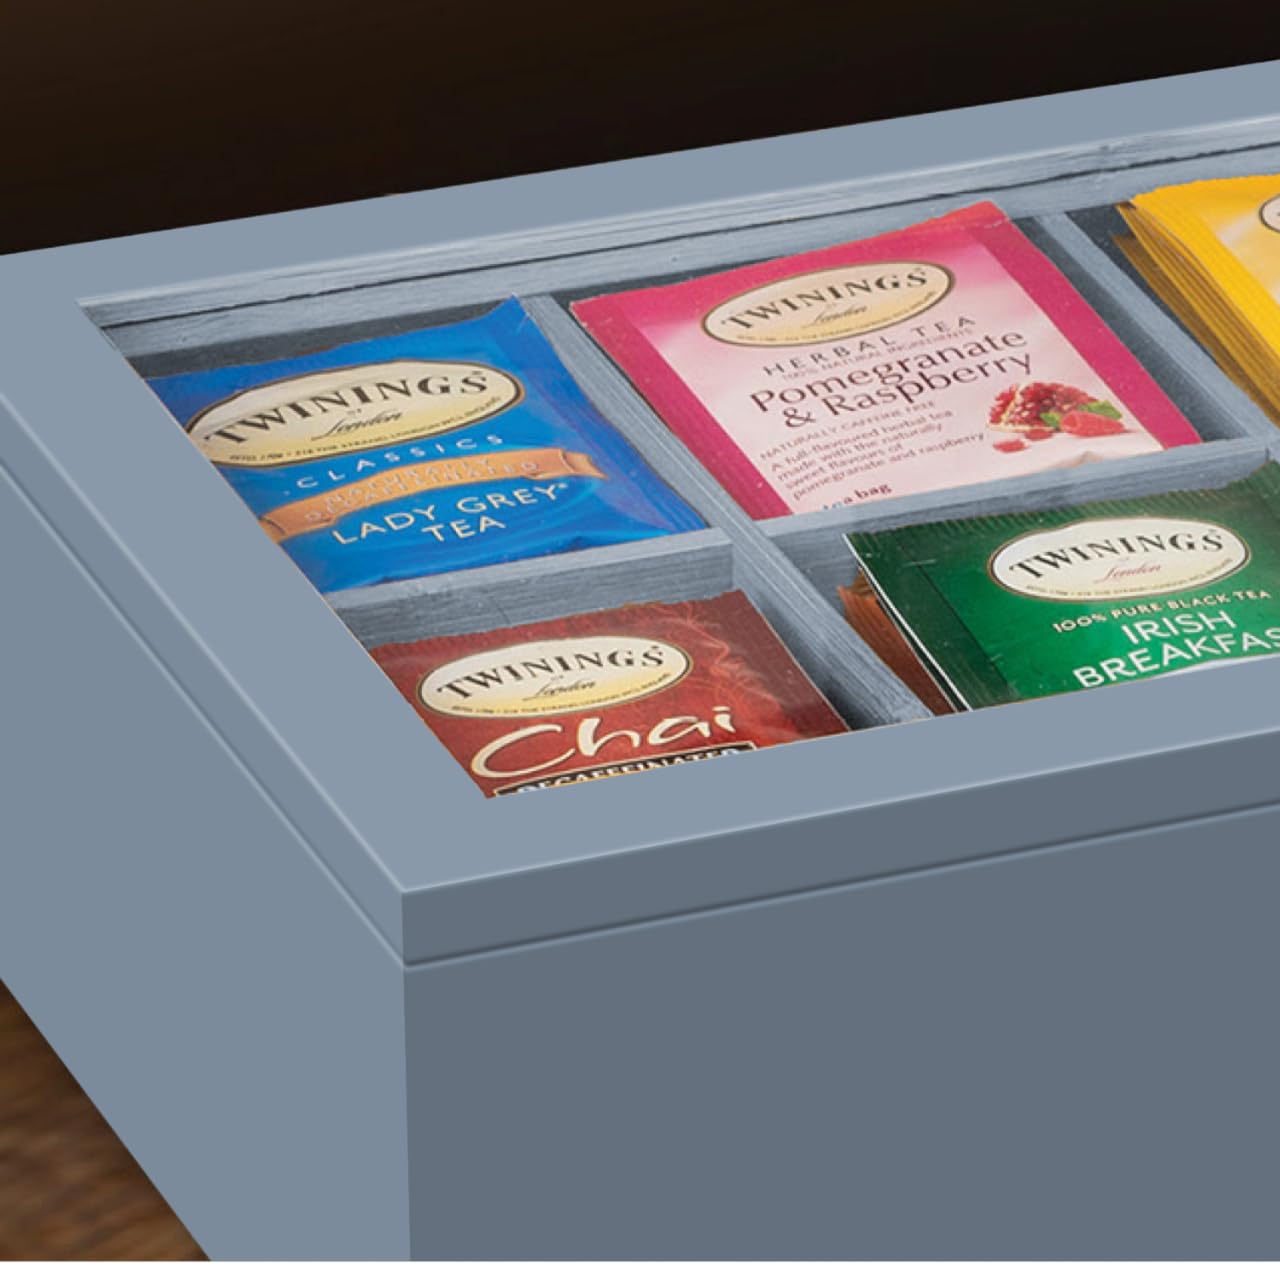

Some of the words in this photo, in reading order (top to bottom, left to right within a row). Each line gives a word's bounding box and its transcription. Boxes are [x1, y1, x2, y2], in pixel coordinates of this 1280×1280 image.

[721, 271, 928, 329] TWININGS
[749, 330, 1028, 412] Pomegranate
[762, 336, 896, 376] HERBAL
[912, 315, 976, 336] TEA
[204, 375, 488, 444] TWININGS
[783, 405, 816, 429] &
[825, 353, 1034, 418] Raspberry
[760, 425, 837, 461] NATURALLY
[881, 416, 926, 434] herbal
[929, 410, 954, 420] tea
[296, 434, 503, 489] CLASSICS
[777, 461, 817, 481] made
[820, 448, 852, 467] with
[854, 437, 881, 453] the
[883, 423, 942, 446] naturally
[785, 466, 827, 490] sweet
[830, 446, 888, 469] flavours
[793, 459, 887, 500] pomegranate
[890, 450, 916, 466] and
[919, 432, 984, 455] raspberry
[331, 504, 436, 545] LADY
[456, 484, 560, 515] GREY
[854, 483, 893, 500] bag
[421, 515, 506, 542] TEA
[1009, 530, 1225, 579] TWININGS
[1053, 613, 1107, 634] 100%
[1111, 602, 1163, 619] PURE
[1167, 594, 1230, 610] BLACK
[1233, 589, 1272, 601] TEA
[1121, 609, 1237, 645] IRISH
[436, 649, 664, 699] TWININGS
[471, 706, 738, 778] Chai
